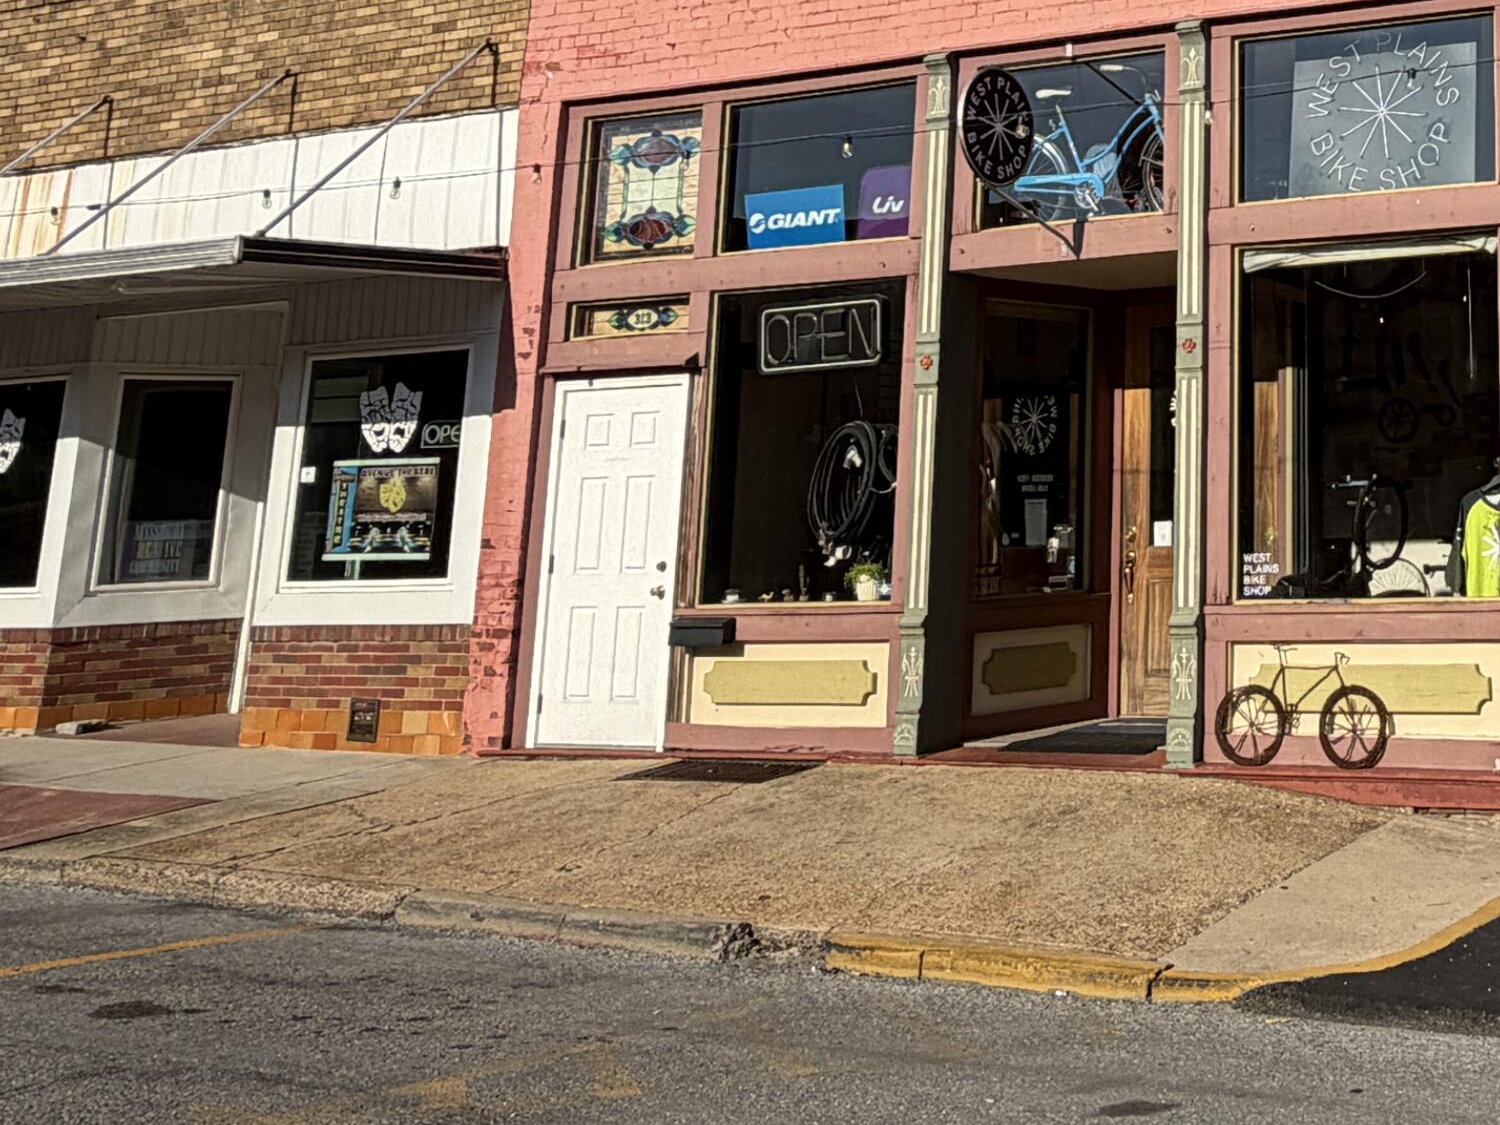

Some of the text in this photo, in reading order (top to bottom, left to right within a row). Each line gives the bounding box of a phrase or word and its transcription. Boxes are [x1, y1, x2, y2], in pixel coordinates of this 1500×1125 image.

[1305, 32, 1459, 117] WEST PLAINS
[966, 77, 1031, 136] WEST PLAIN
[967, 132, 1026, 179] BIKE SHOP
[1311, 123, 1449, 191] BIKE SHOP
[767, 208, 841, 230] GIANT
[766, 306, 877, 365] OPEN
[425, 424, 461, 444] OPE
[1243, 553, 1272, 563] WEST
[1243, 563, 1280, 574] PLAINS
[1243, 574, 1267, 585] BIKE
[1243, 585, 1272, 596] SHOP
